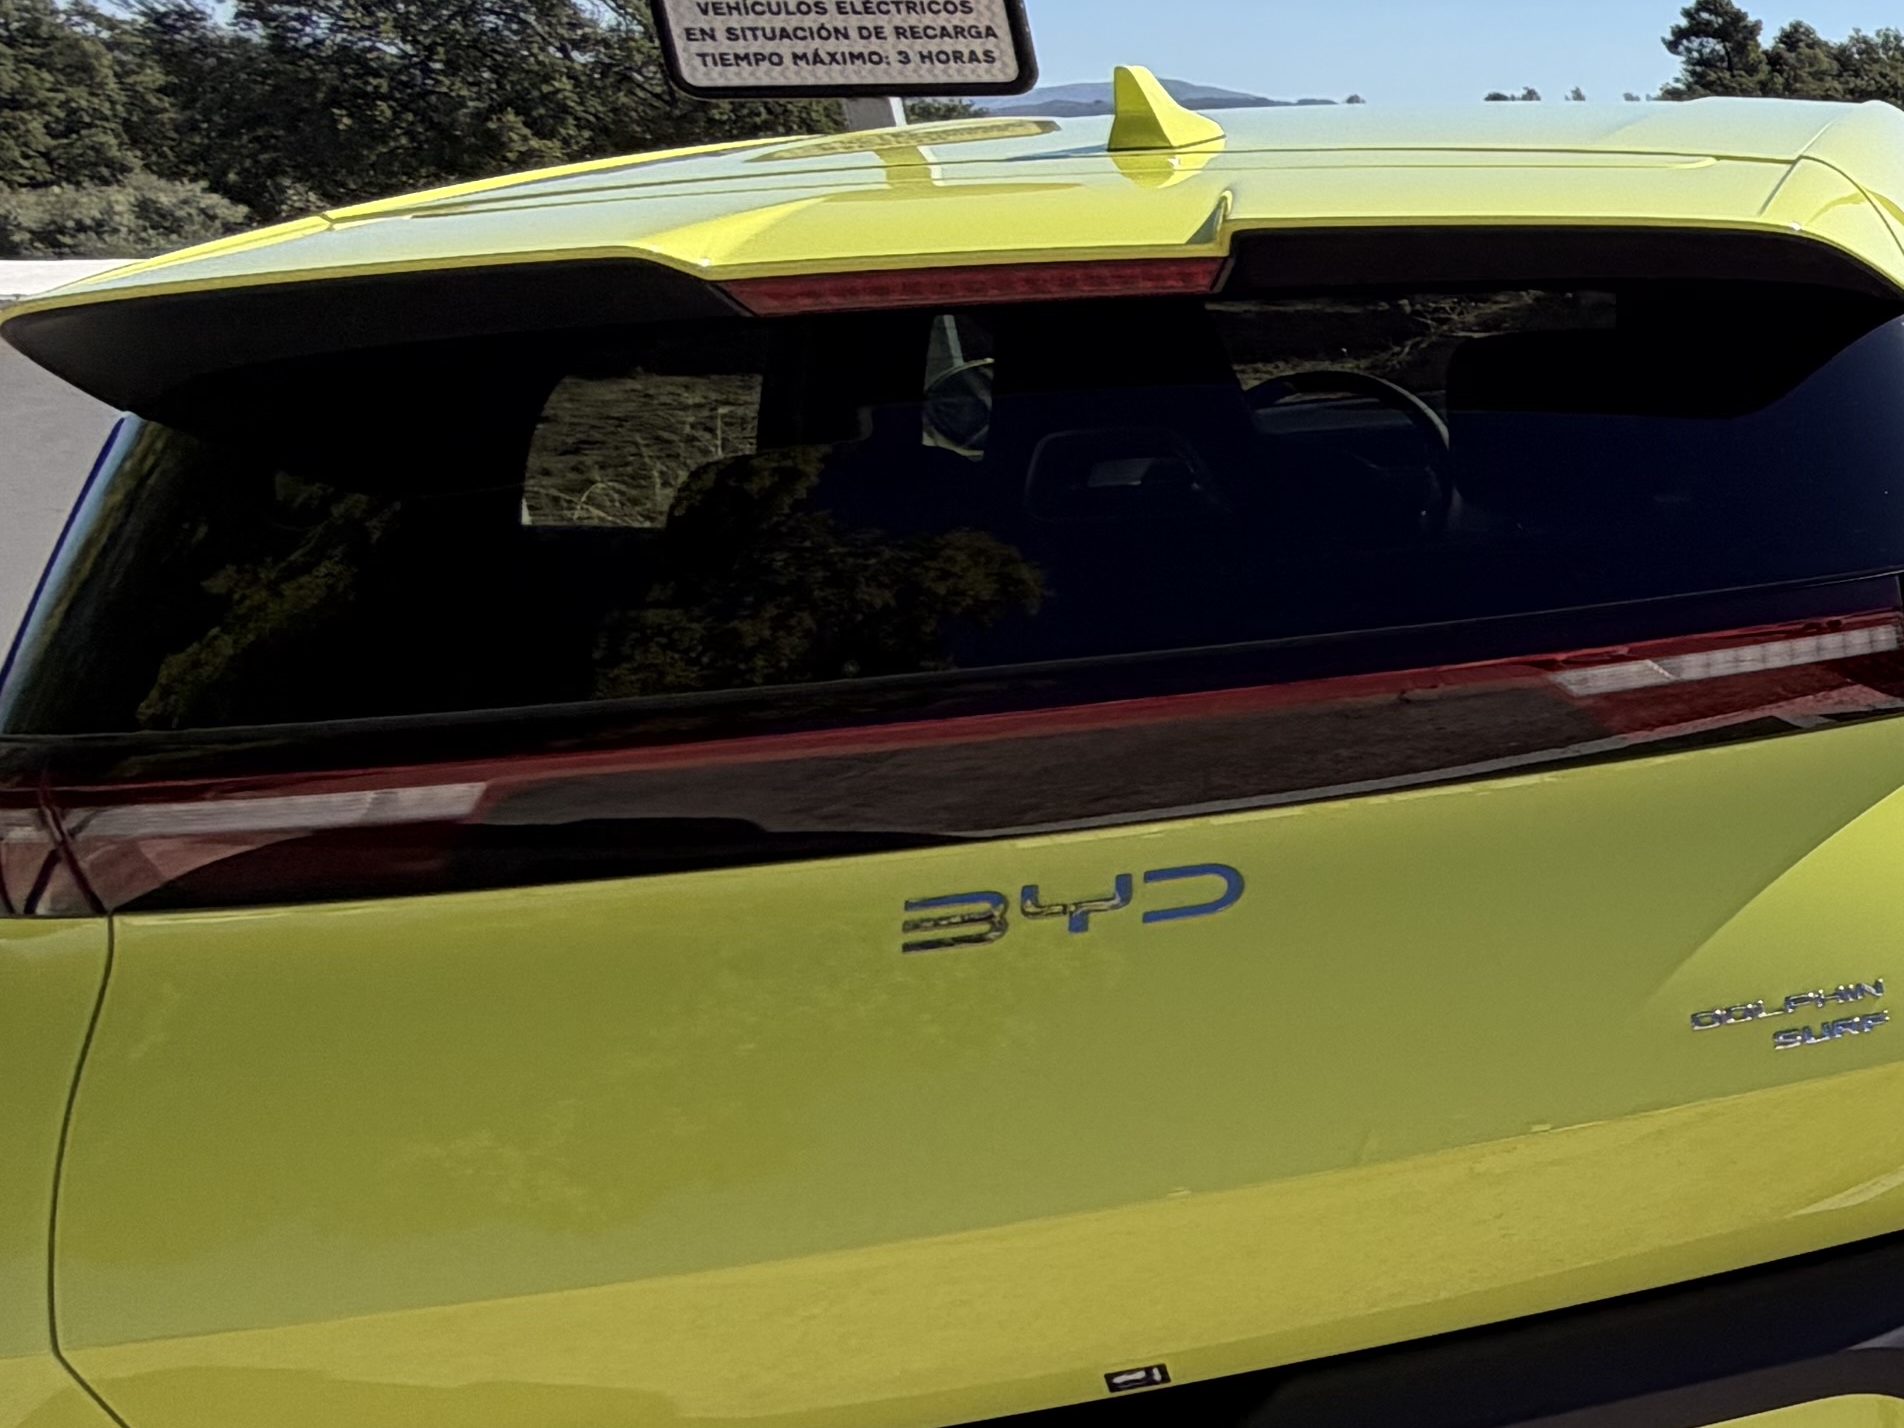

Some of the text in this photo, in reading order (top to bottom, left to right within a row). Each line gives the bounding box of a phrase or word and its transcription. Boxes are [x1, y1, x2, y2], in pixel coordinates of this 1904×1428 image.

[684, 23, 998, 42] EN SITUACIÓN DE RECARGA
[696, 48, 996, 67] TIEMPO MÁXIMO: 3 HORAS
[902, 863, 1244, 953] BYD
[1690, 978, 1885, 1030] DOLPHIN
[1772, 1009, 1890, 1050] SURF
